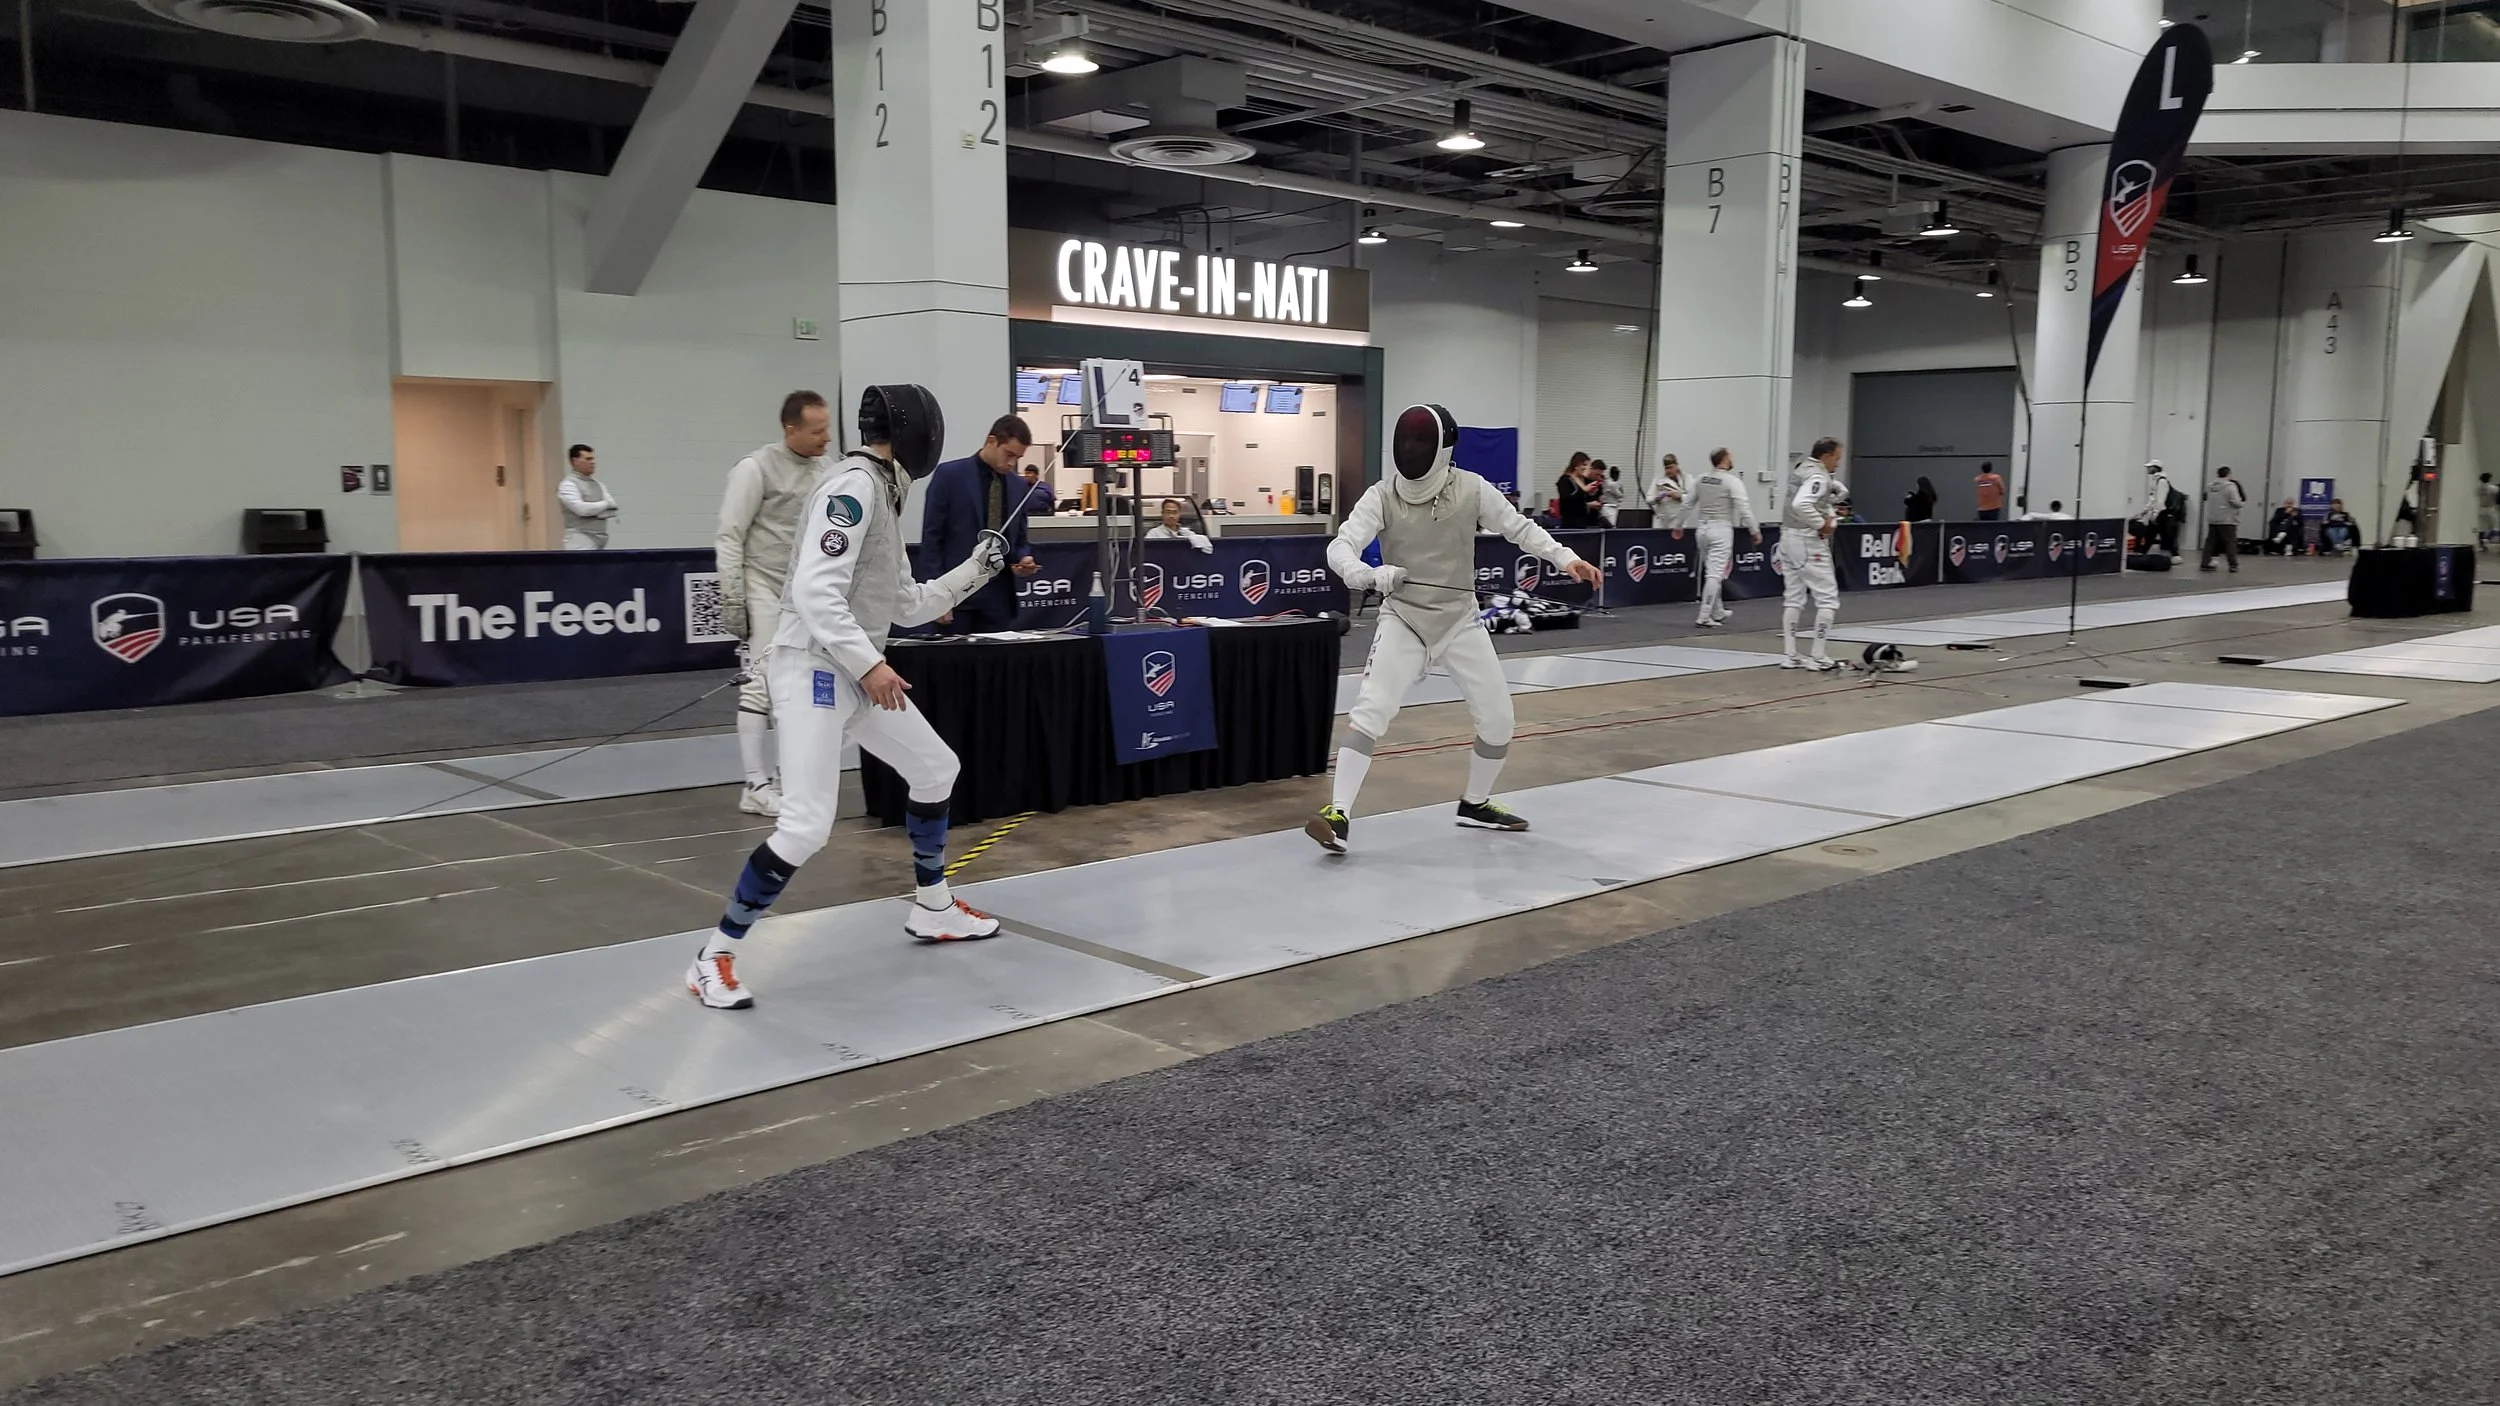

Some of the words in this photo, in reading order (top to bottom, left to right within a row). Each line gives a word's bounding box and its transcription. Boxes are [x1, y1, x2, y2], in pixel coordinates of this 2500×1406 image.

[2159, 46, 2183, 110] L
[1708, 167, 1725, 234] B7
[2064, 240, 2081, 292] B3
[1058, 239, 1329, 324] CRAVE-IN-NATI
[2324, 291, 2343, 354] A43
[1129, 369, 1141, 386] 4
[1094, 366, 1131, 425] L
[1653, 554, 1686, 566] USA
[1736, 552, 1764, 564] USA
[1173, 573, 1225, 589] USA
[1281, 569, 1326, 584] USA
[1020, 598, 1077, 608] RAFENCING
[1178, 592, 1220, 600] FENCING
[189, 604, 299, 630] USA
[408, 593, 517, 642] The
[523, 587, 662, 637] Feed.
[179, 629, 312, 646] PARAFENCING
